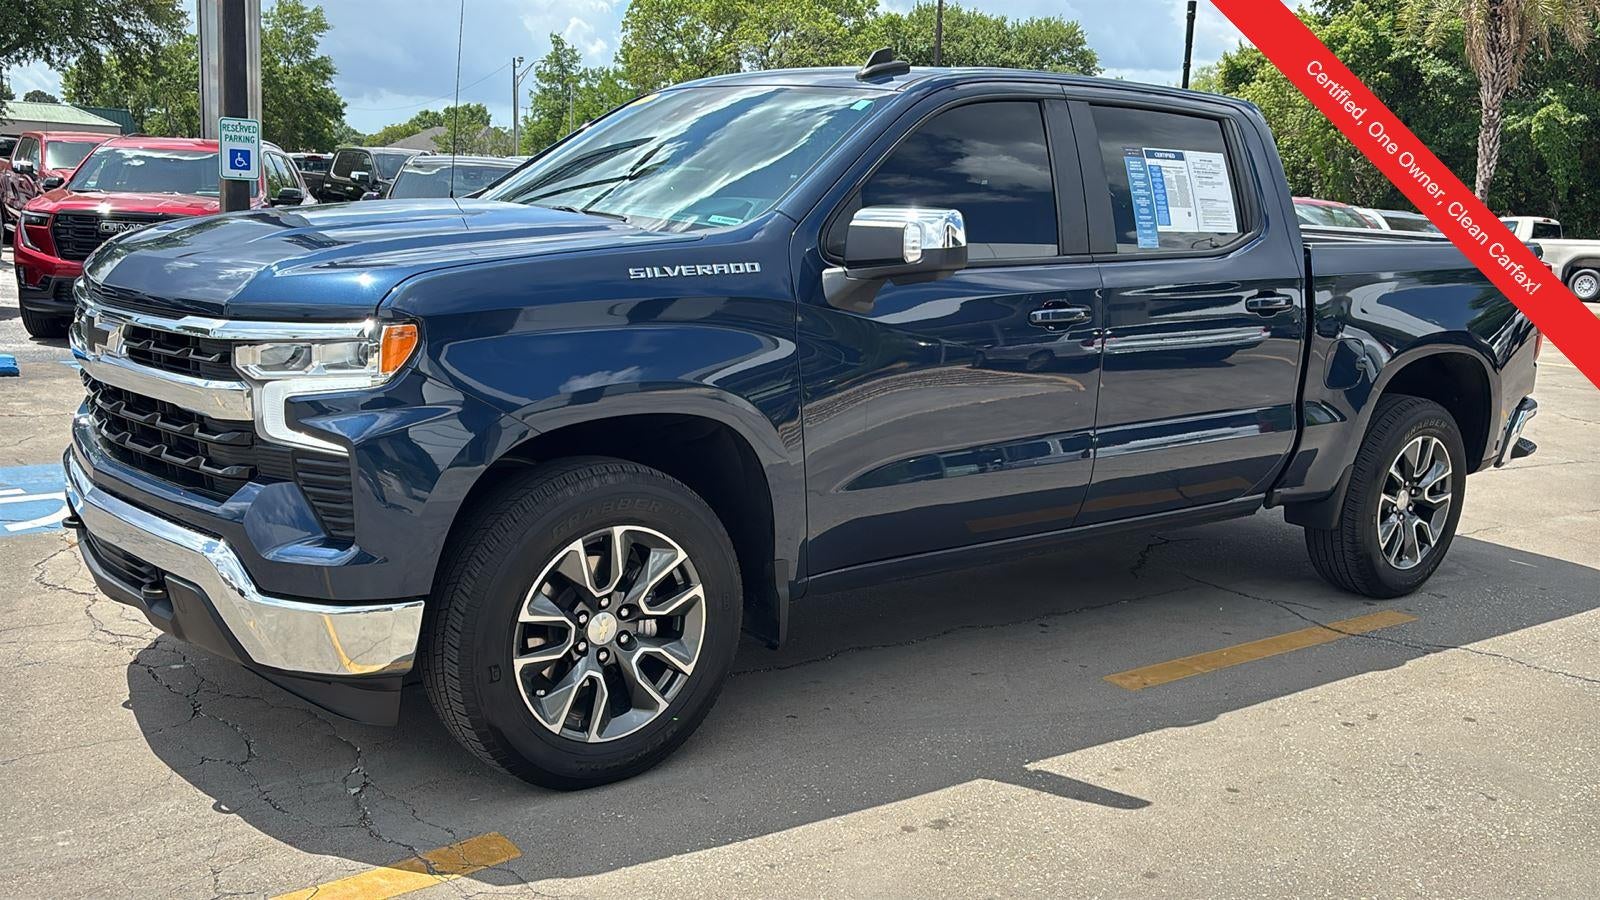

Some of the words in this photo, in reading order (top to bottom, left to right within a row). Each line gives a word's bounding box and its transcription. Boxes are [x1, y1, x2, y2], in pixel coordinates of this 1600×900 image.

[222, 123, 257, 133] RESERVED
[224, 133, 255, 144] PARKING
[628, 262, 761, 279] SILVERADO
[551, 496, 664, 540] GRABBER
